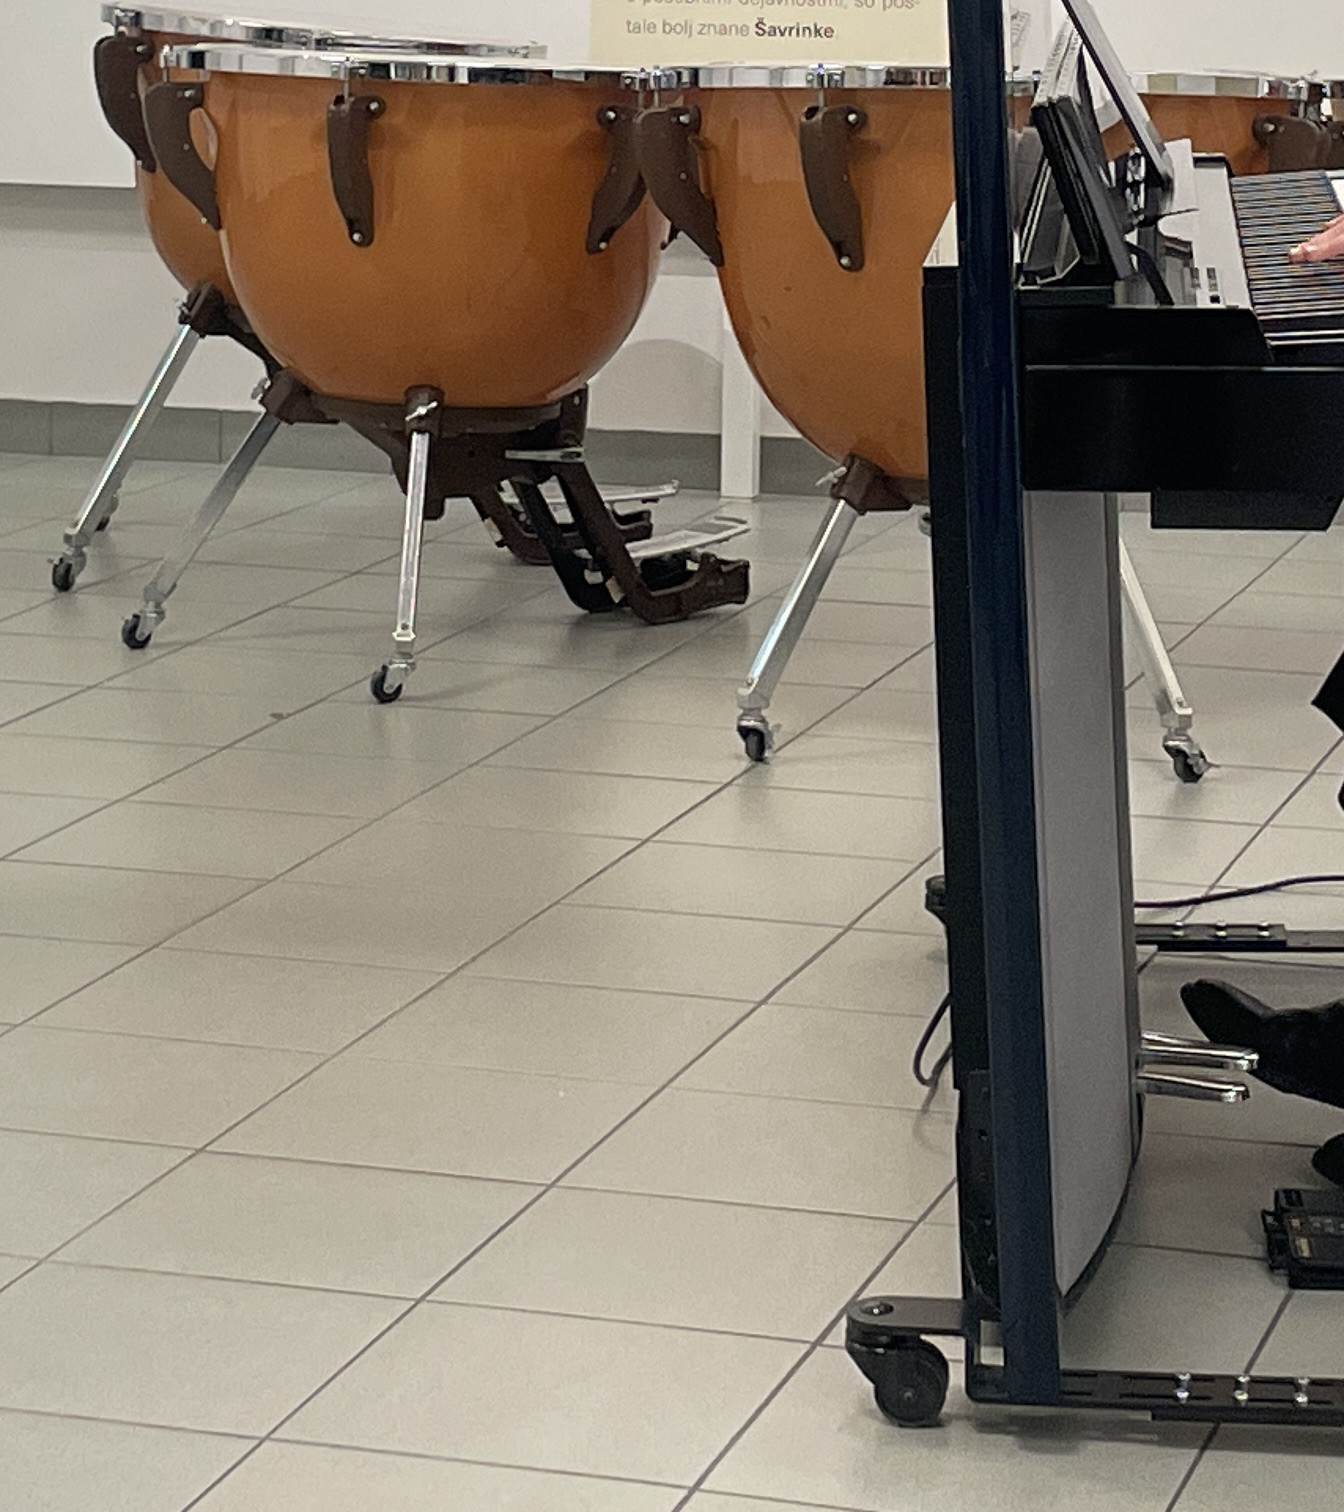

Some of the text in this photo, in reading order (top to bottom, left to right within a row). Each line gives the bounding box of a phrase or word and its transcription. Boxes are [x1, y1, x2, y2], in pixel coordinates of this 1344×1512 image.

[627, 19, 657, 34] tale
[662, 19, 692, 38] bolj
[698, 23, 750, 36] znane
